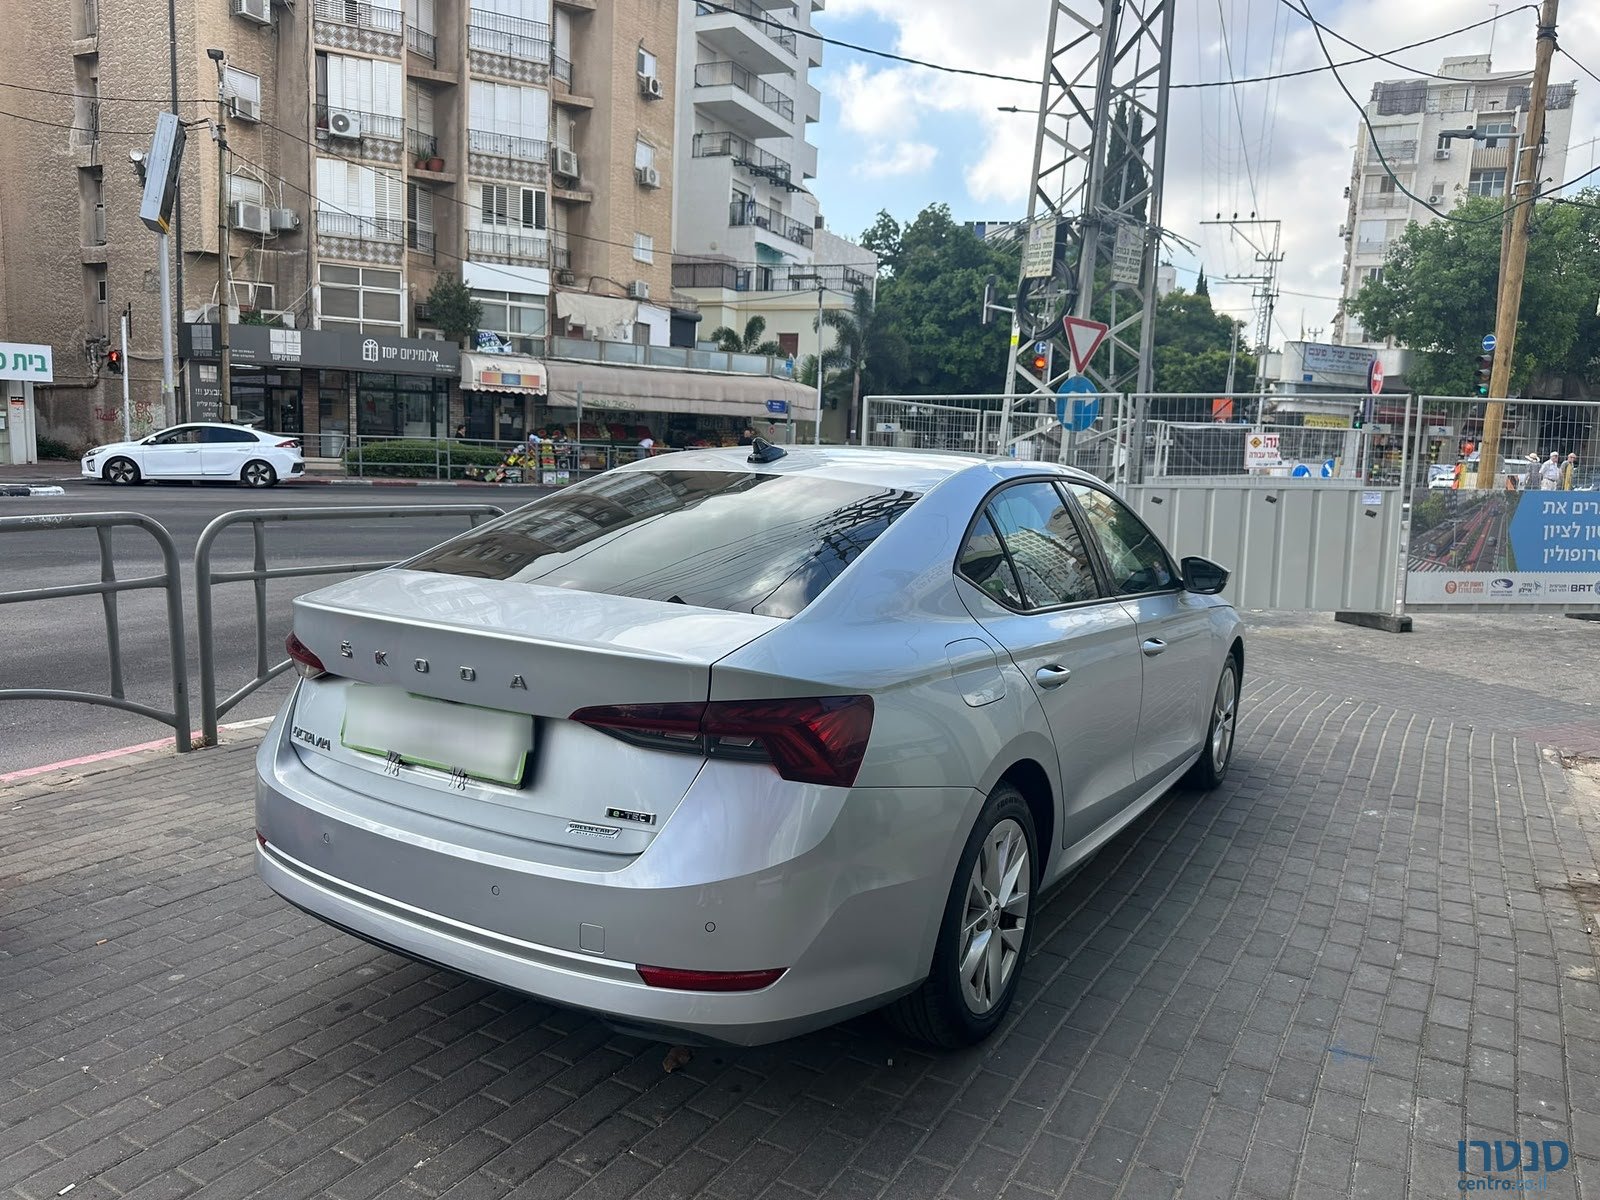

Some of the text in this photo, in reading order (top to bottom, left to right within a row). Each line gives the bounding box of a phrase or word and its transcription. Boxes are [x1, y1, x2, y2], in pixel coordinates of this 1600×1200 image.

[382, 346, 439, 362] אלומיניום TOP
[1332, 347, 1345, 358] של
[12, 353, 48, 372] בית
[1542, 501, 1600, 515] רים את
[1543, 522, 1581, 540] לציון
[1570, 584, 1593, 592] BRT
[340, 640, 528, 690] ŠKODA
[612, 810, 647, 822] e-TEC
[569, 823, 594, 831] GREEN
